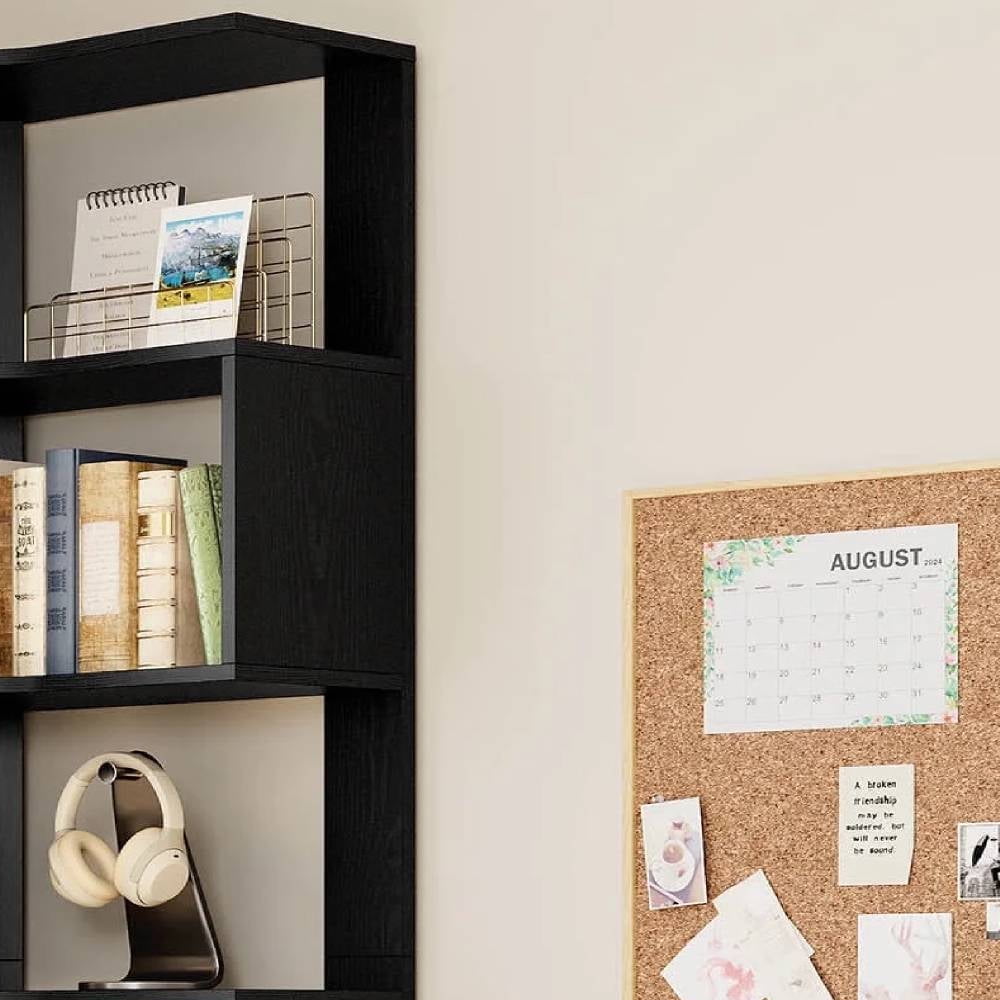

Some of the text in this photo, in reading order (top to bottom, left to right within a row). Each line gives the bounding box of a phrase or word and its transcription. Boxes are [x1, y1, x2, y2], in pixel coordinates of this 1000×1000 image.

[830, 547, 923, 571] AUGUST
[854, 780, 897, 789] A broken
